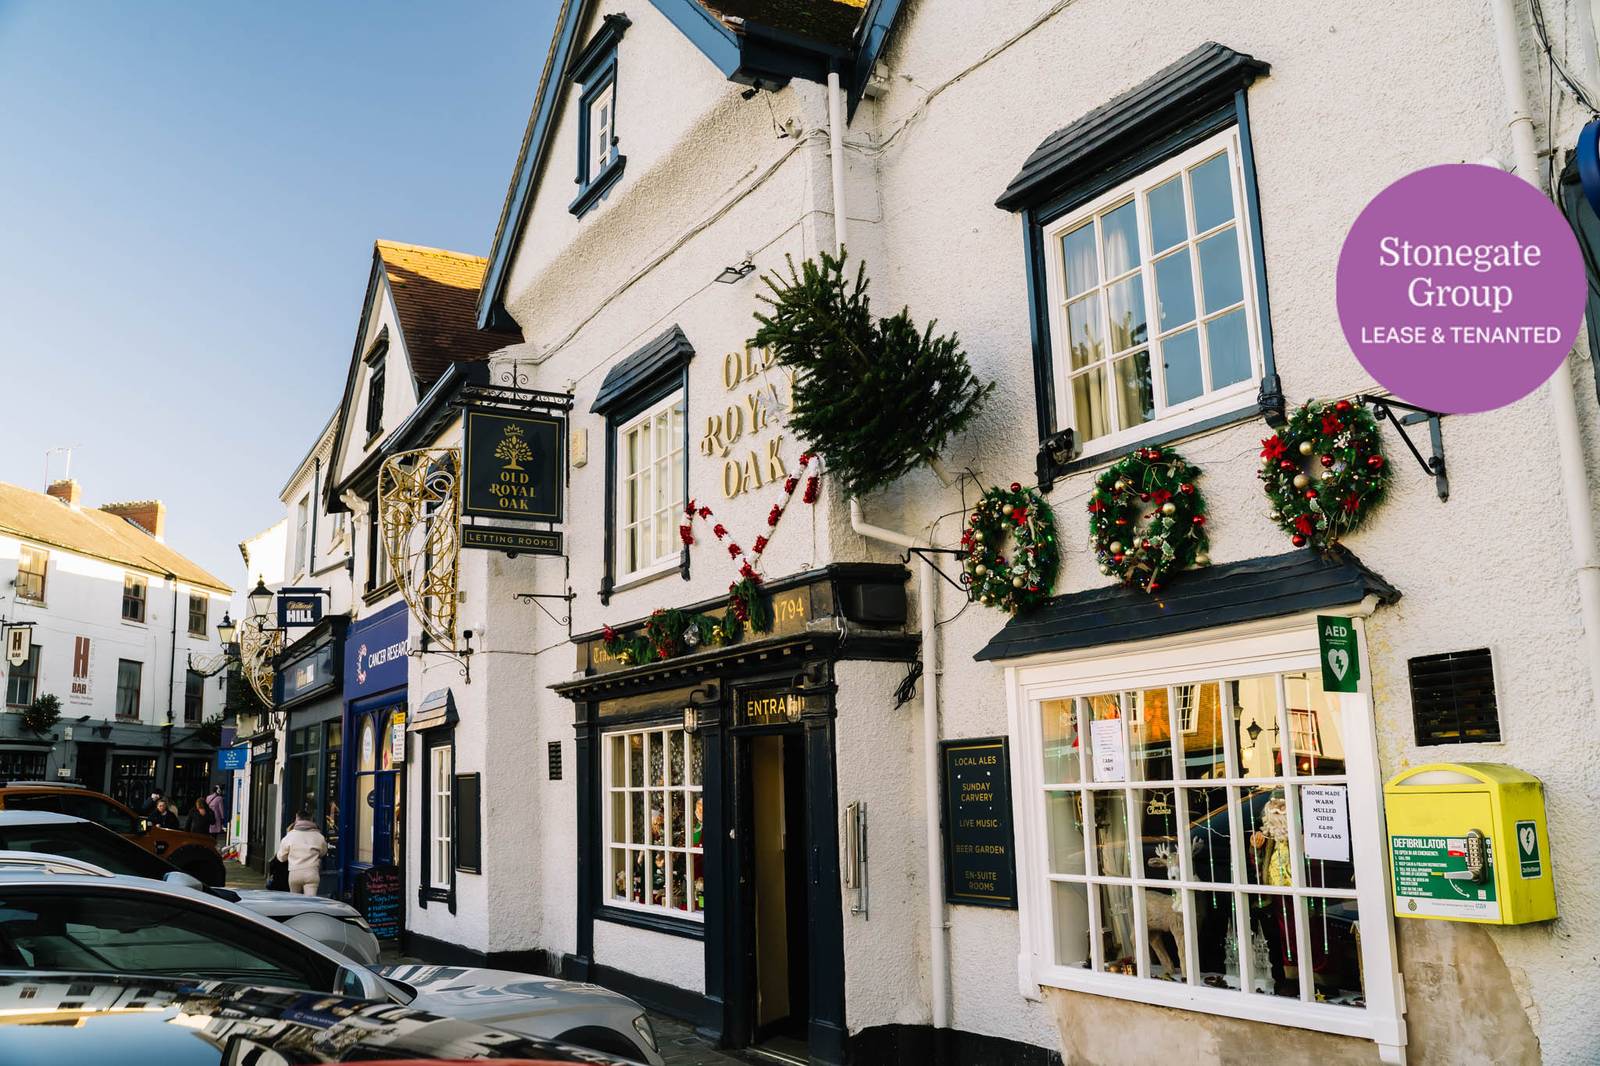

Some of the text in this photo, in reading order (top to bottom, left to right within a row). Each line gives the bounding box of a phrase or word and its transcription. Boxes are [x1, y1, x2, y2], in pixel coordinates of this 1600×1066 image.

[723, 434, 787, 498] OAK
[500, 471, 529, 484] OLD
[490, 483, 536, 497] ROYAL
[499, 497, 529, 510] OAK
[469, 533, 554, 547] LETTING ROOMS
[287, 610, 314, 622] HILL
[773, 596, 804, 624] 1794
[1325, 625, 1347, 637] AED
[13, 631, 22, 650] H
[73, 636, 90, 679] H
[368, 640, 409, 668] CANCER RESEARC
[71, 682, 87, 695] BAR
[955, 756, 997, 766] LOCAL ALES
[962, 782, 991, 791] SUNDAY
[961, 793, 993, 802] CARVERY
[959, 819, 998, 828] LIVE MUSIC
[956, 844, 1005, 854] BEER GARDEN
[1393, 838, 1447, 849] DEFIBRILLATOR
[965, 870, 997, 881] EN-SUITE
[968, 880, 995, 892] ROOMS
